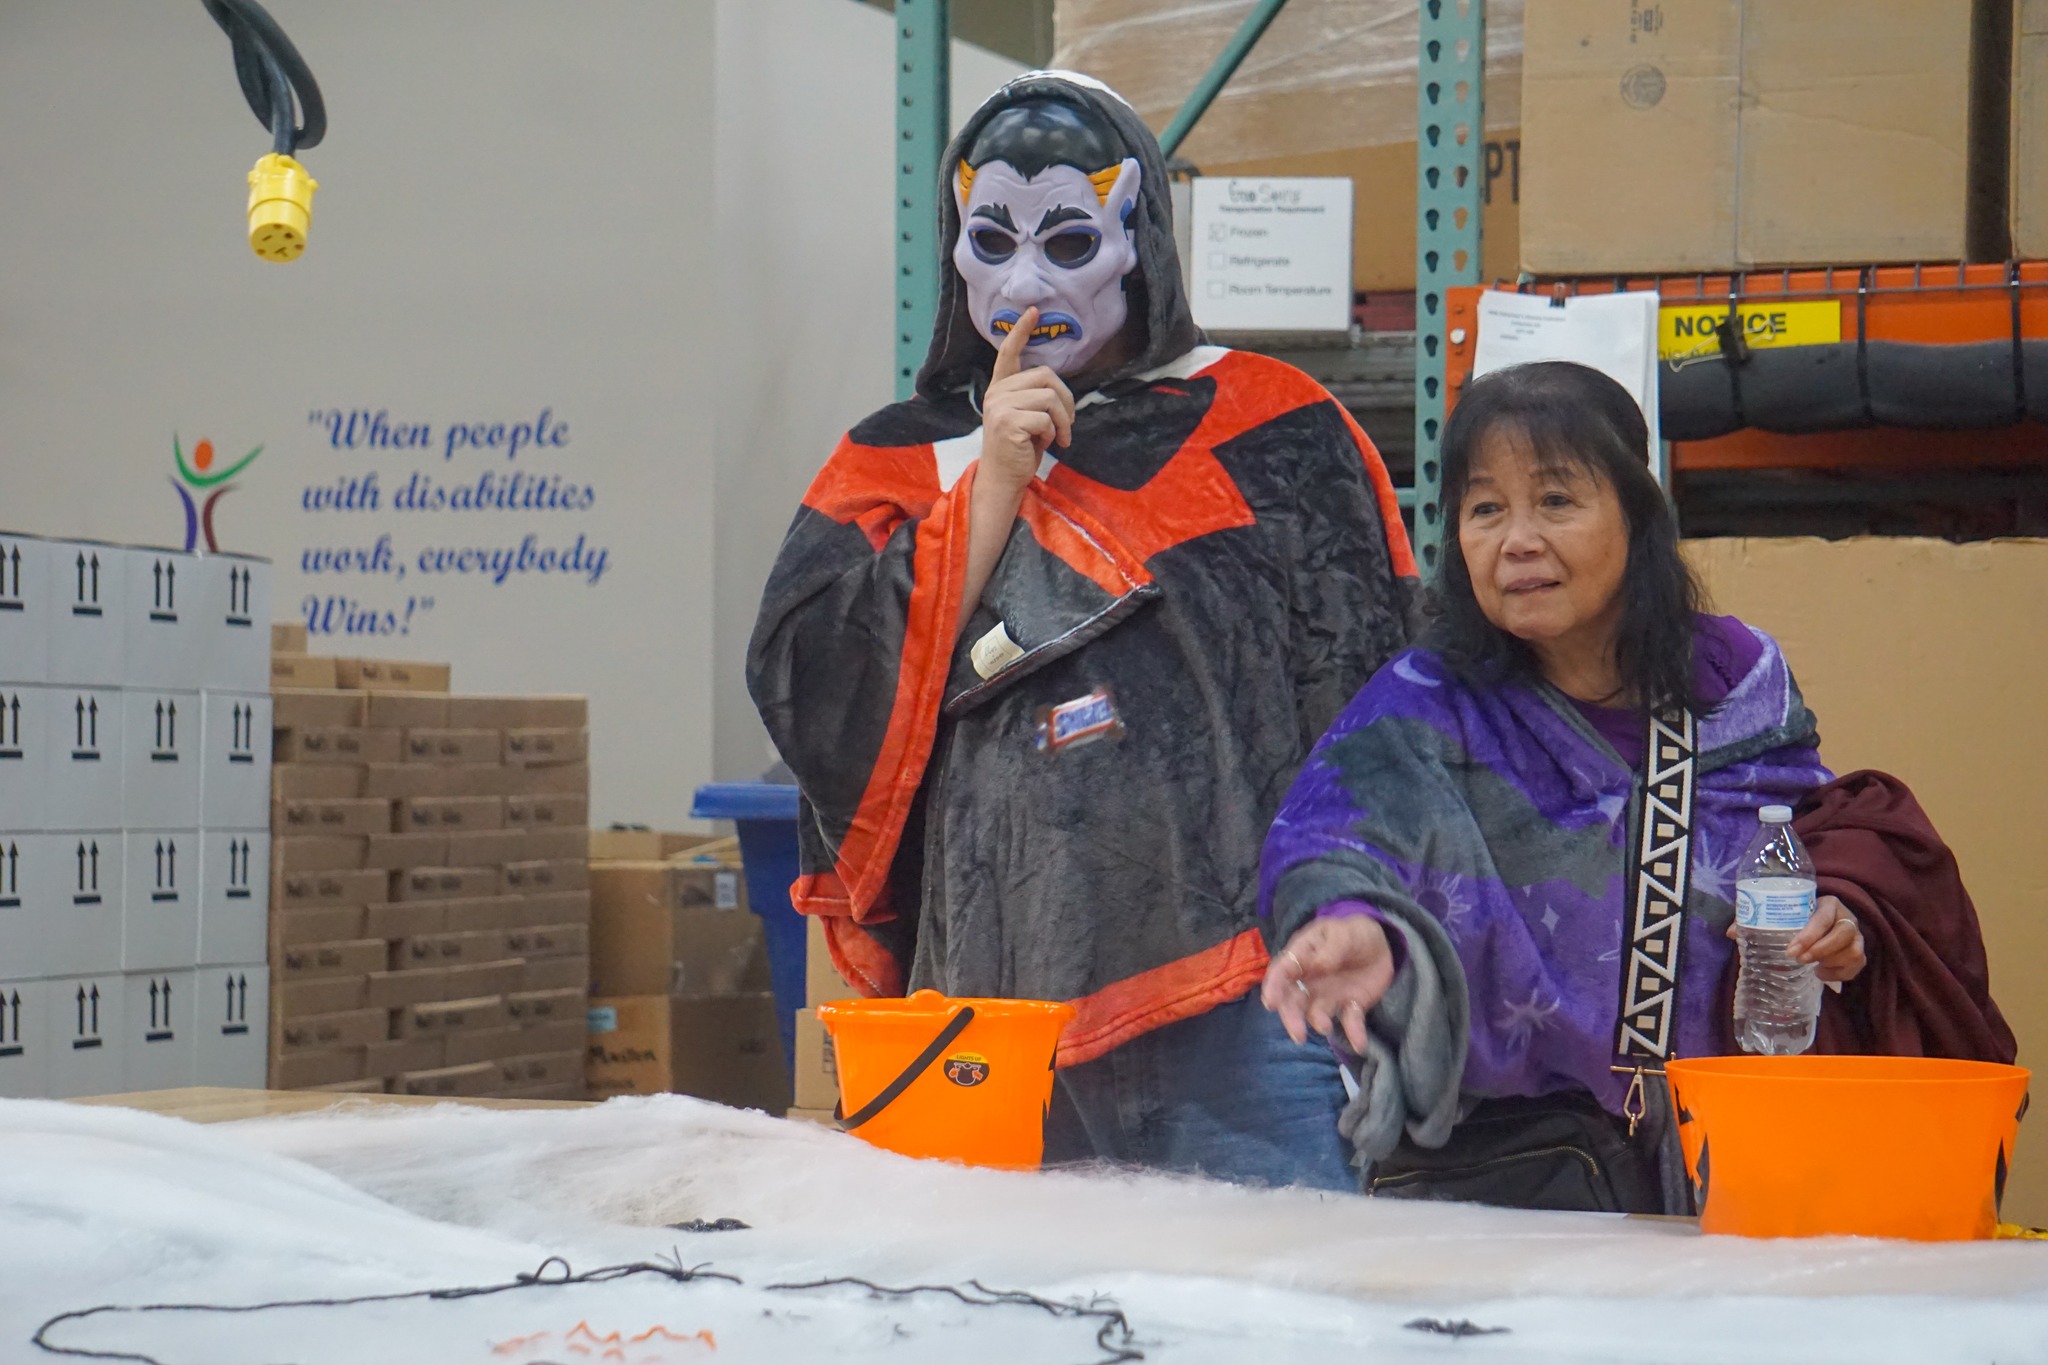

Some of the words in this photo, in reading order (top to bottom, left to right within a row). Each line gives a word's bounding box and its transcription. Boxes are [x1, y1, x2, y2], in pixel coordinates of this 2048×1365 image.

[1230, 226, 1269, 238] Frozen
[1229, 256, 1291, 269] Refrigerate
[1229, 285, 1261, 296] Room
[1265, 285, 1332, 297] Temperature
[443, 407, 569, 460] people
[300, 471, 381, 512] with
[392, 471, 596, 512] disabilities
[299, 533, 406, 581] work,
[416, 533, 609, 586] everybody
[300, 594, 435, 636] Wins!"
